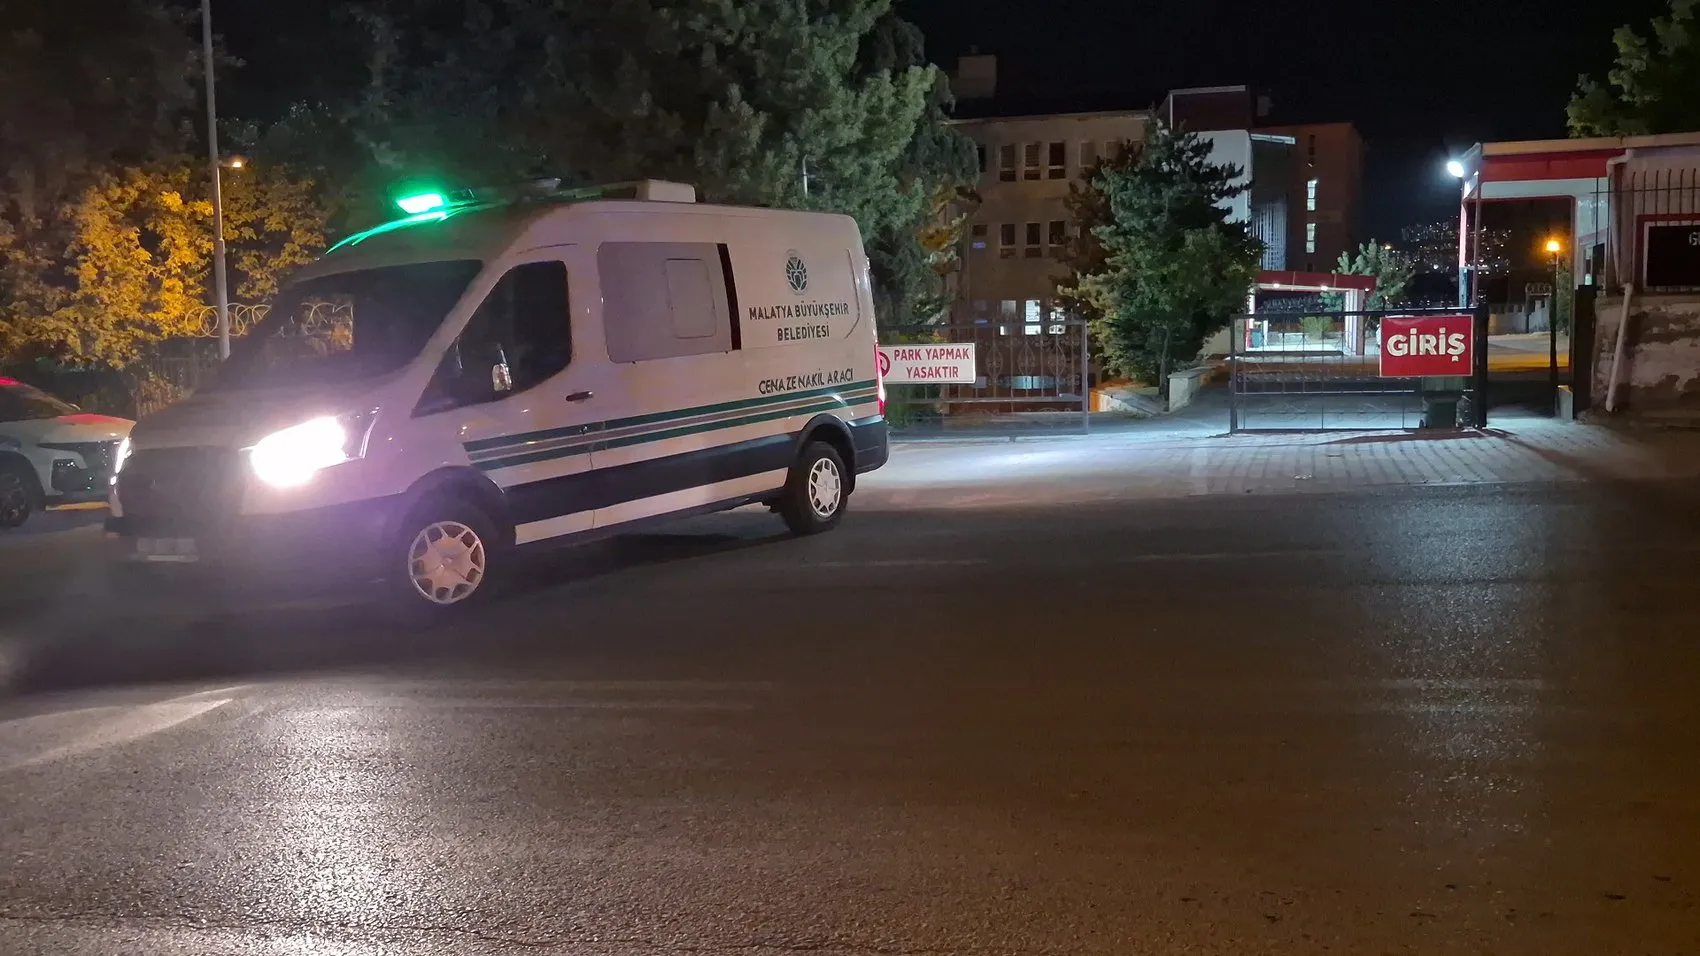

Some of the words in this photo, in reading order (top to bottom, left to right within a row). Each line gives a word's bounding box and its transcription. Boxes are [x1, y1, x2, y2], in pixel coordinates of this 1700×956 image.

[749, 305, 793, 320] MALATYA
[794, 299, 849, 318] BÜYÜKŞEHİR
[777, 322, 830, 341] BELEDİYESİ
[894, 349, 922, 361] PARK
[926, 348, 970, 360] YAPMAK
[1386, 327, 1466, 362] GİRİŞ
[758, 375, 797, 395] CENAZE
[798, 368, 825, 389] NAKİL
[827, 367, 854, 384] ARACI
[906, 366, 959, 379] YASAKTIR
